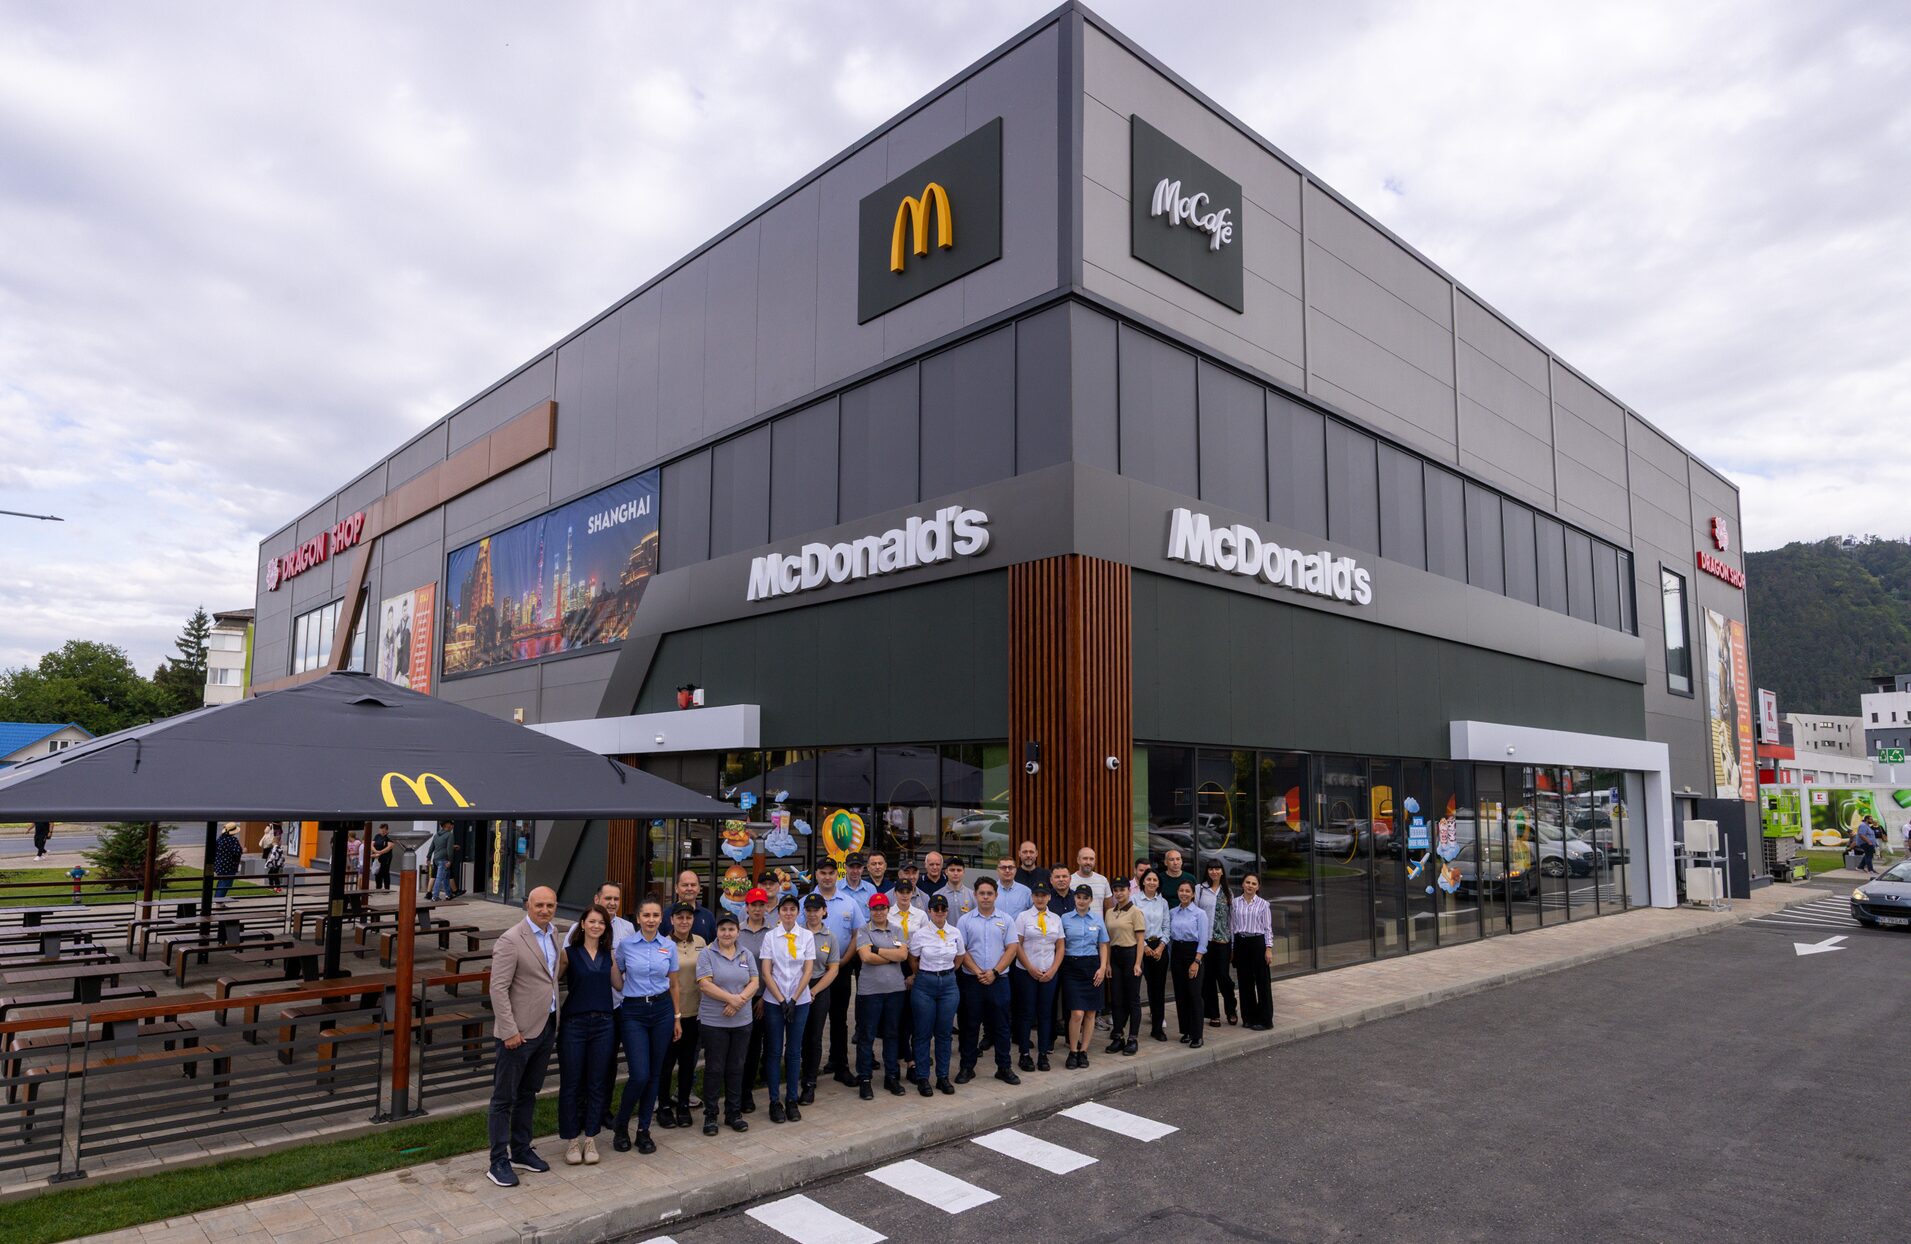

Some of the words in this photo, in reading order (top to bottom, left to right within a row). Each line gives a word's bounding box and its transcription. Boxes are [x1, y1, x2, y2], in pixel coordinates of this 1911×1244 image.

[1151, 178, 1234, 251] McCafé
[282, 531, 328, 582] DRAGON
[330, 511, 365, 556] SHOP
[587, 494, 651, 535] SHANGHAI
[747, 505, 990, 602] McDonald's
[1167, 507, 1372, 606] McDonald's
[1697, 550, 1730, 581] DRAGON
